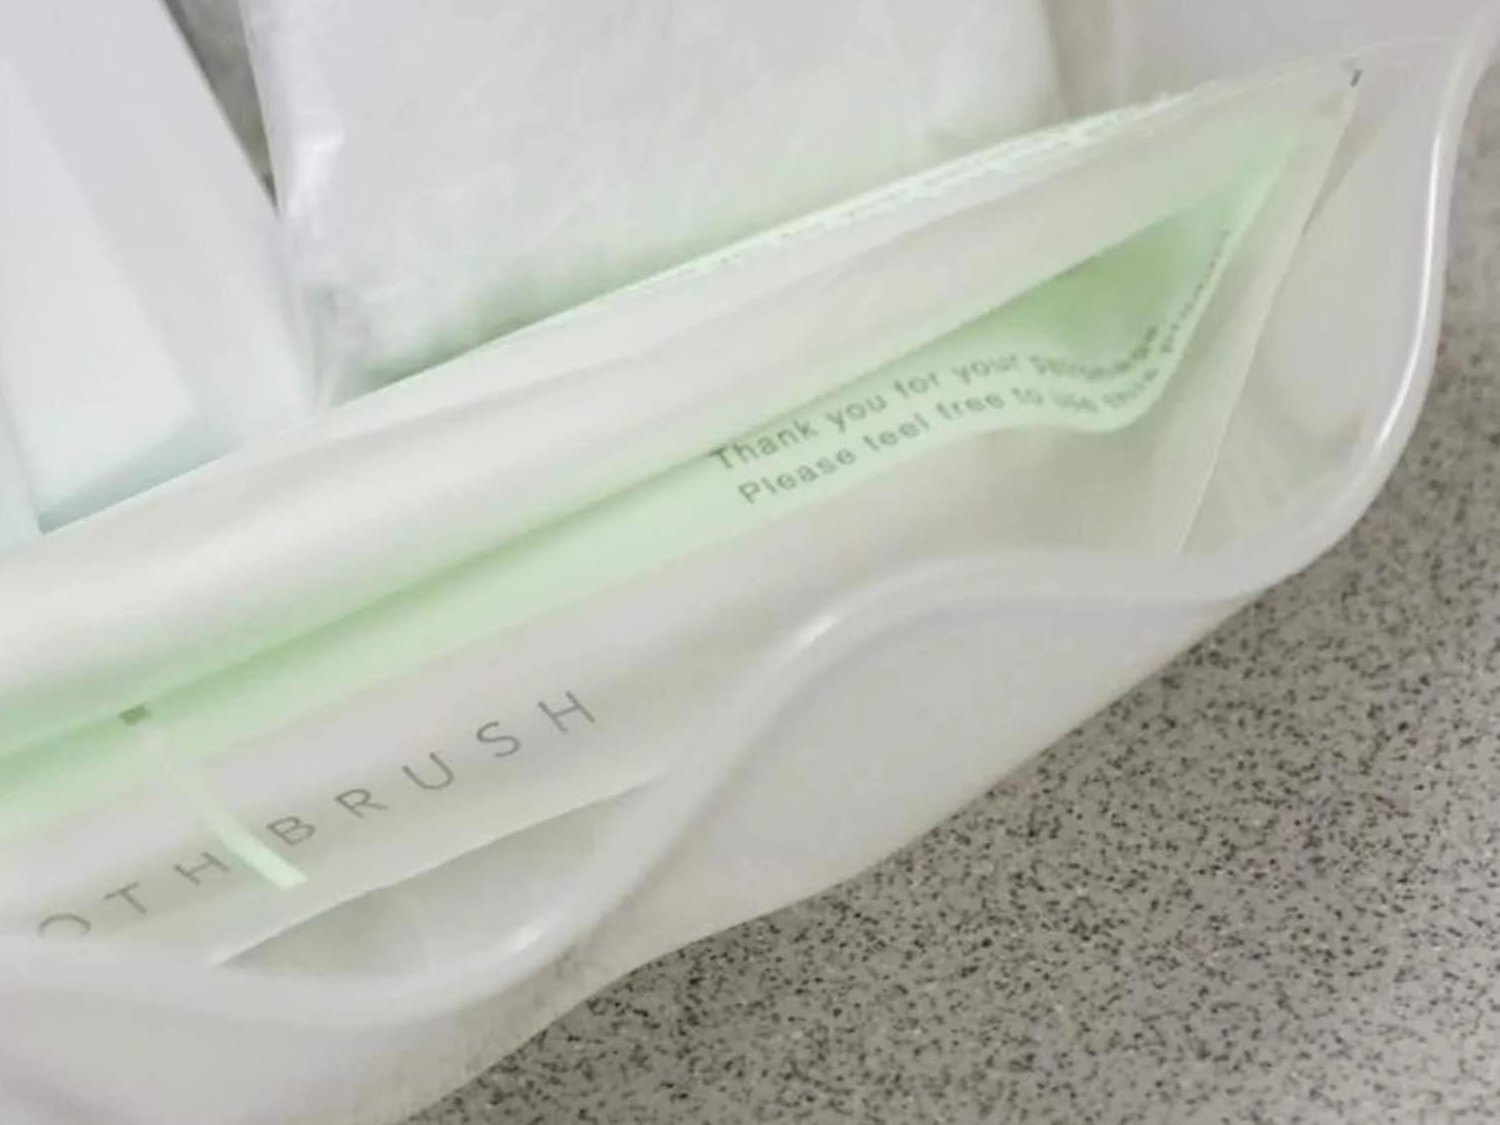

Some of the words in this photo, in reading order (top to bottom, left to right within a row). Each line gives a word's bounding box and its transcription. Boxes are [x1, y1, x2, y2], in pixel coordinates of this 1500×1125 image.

[709, 417, 818, 472] Thank
[825, 390, 889, 433] you
[892, 369, 943, 402] for
[951, 352, 1021, 386] your
[737, 447, 858, 505] Please
[862, 413, 932, 453] feel
[935, 390, 1007, 424] free
